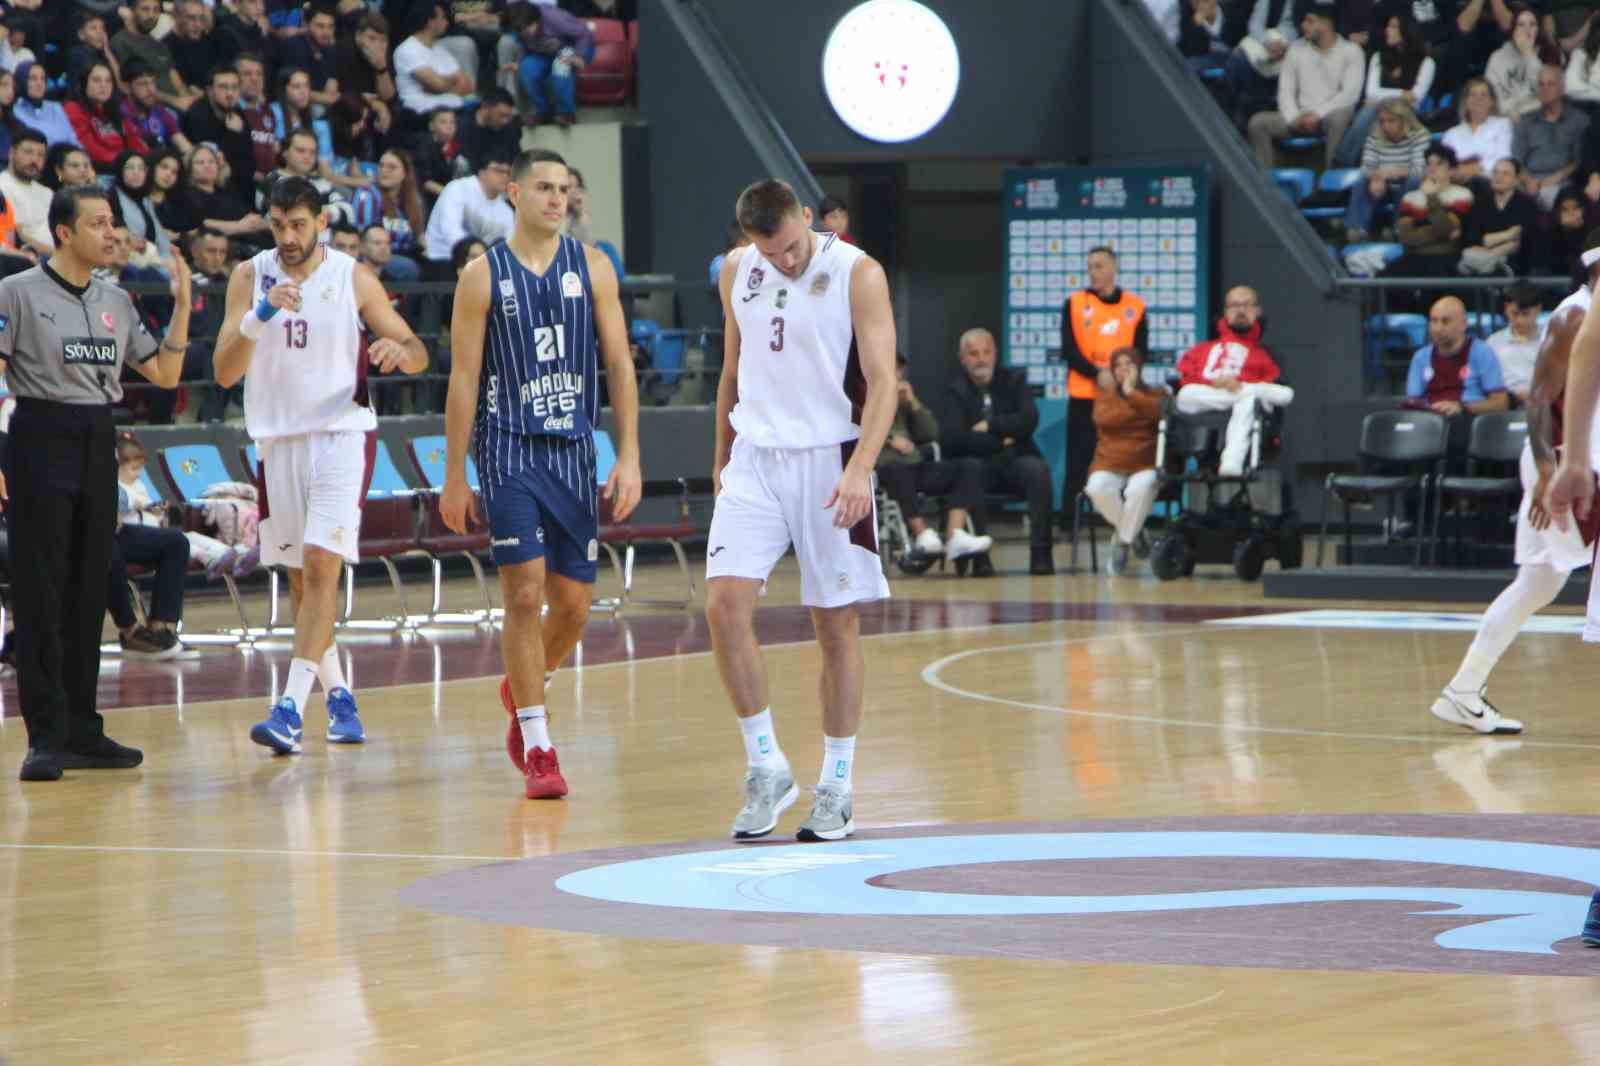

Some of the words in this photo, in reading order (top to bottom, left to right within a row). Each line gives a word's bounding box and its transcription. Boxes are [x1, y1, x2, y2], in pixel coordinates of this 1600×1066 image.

[283, 319, 308, 349] 13
[534, 324, 565, 363] 21
[769, 316, 785, 352] 3
